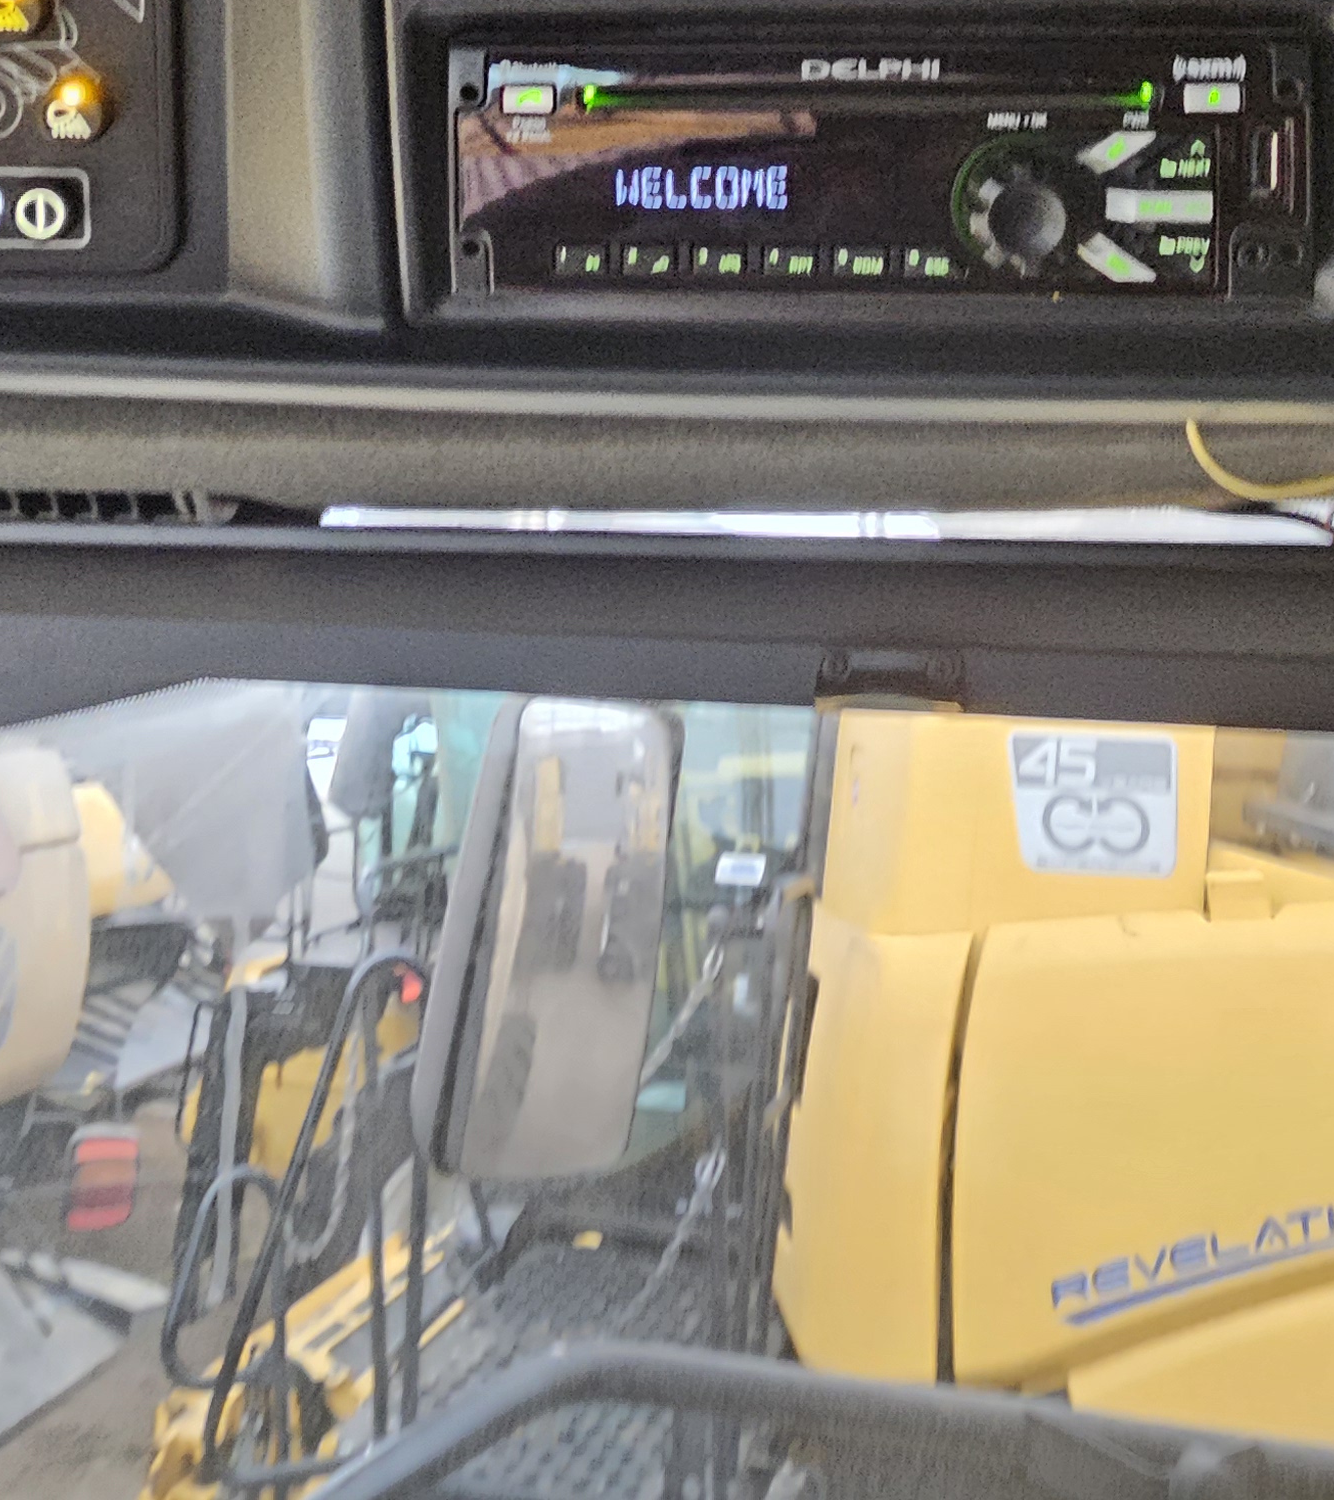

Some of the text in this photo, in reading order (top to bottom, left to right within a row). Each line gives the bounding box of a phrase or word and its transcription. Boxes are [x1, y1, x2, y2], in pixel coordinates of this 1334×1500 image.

[801, 57, 940, 82] DELPHI
[615, 164, 788, 210] WELCOME
[1019, 735, 1096, 790] 45
